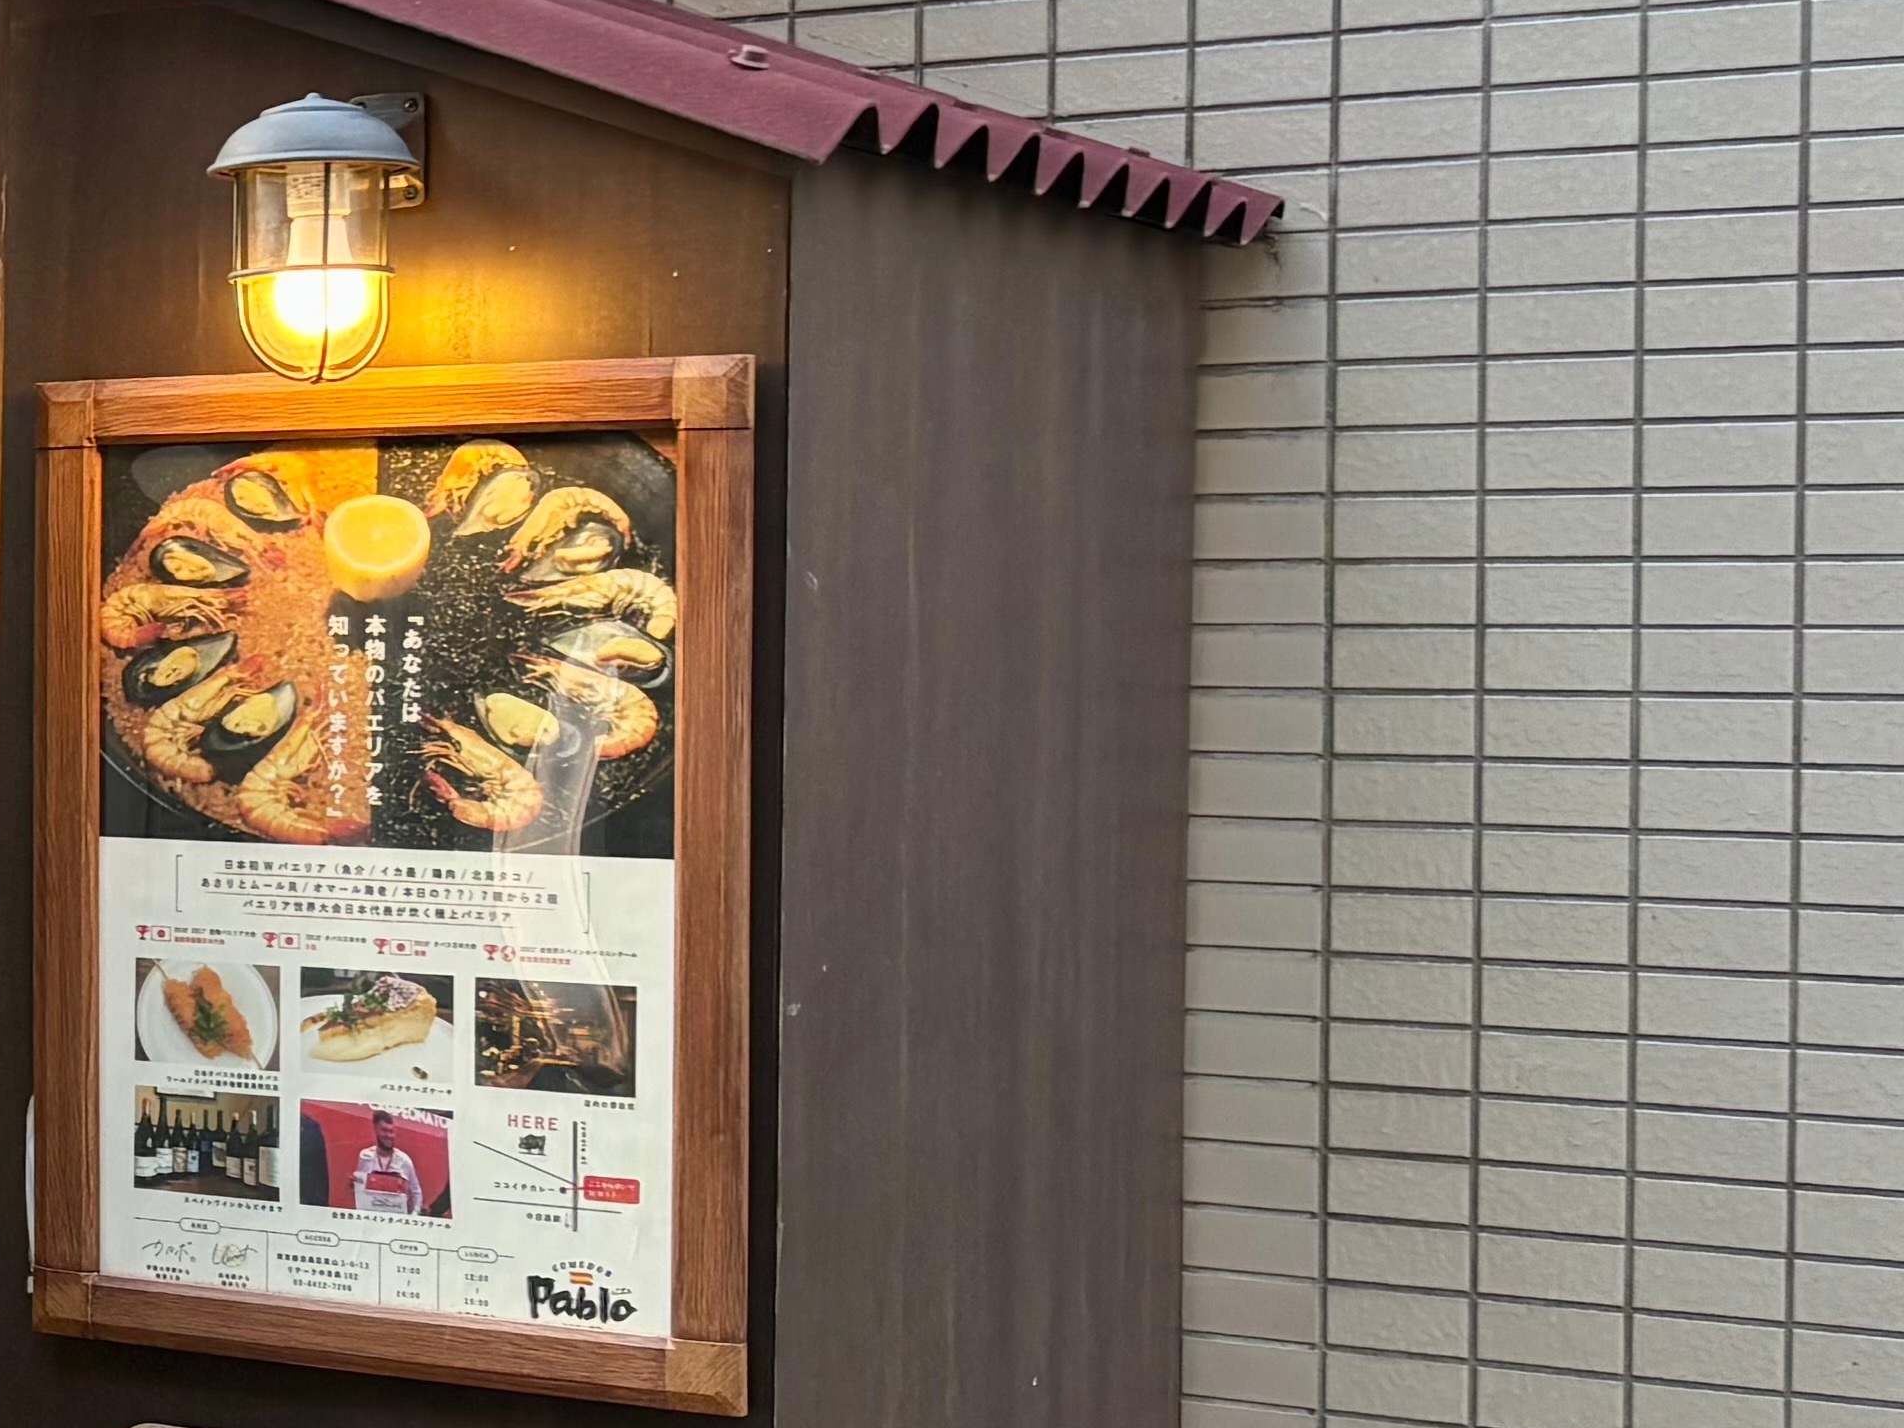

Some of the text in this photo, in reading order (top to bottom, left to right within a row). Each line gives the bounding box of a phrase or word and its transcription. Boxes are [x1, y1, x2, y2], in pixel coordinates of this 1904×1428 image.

[364, 614, 386, 806] 本物のパエリアを
[507, 1114, 559, 1131] HERE
[526, 1275, 638, 1324] Pablo
